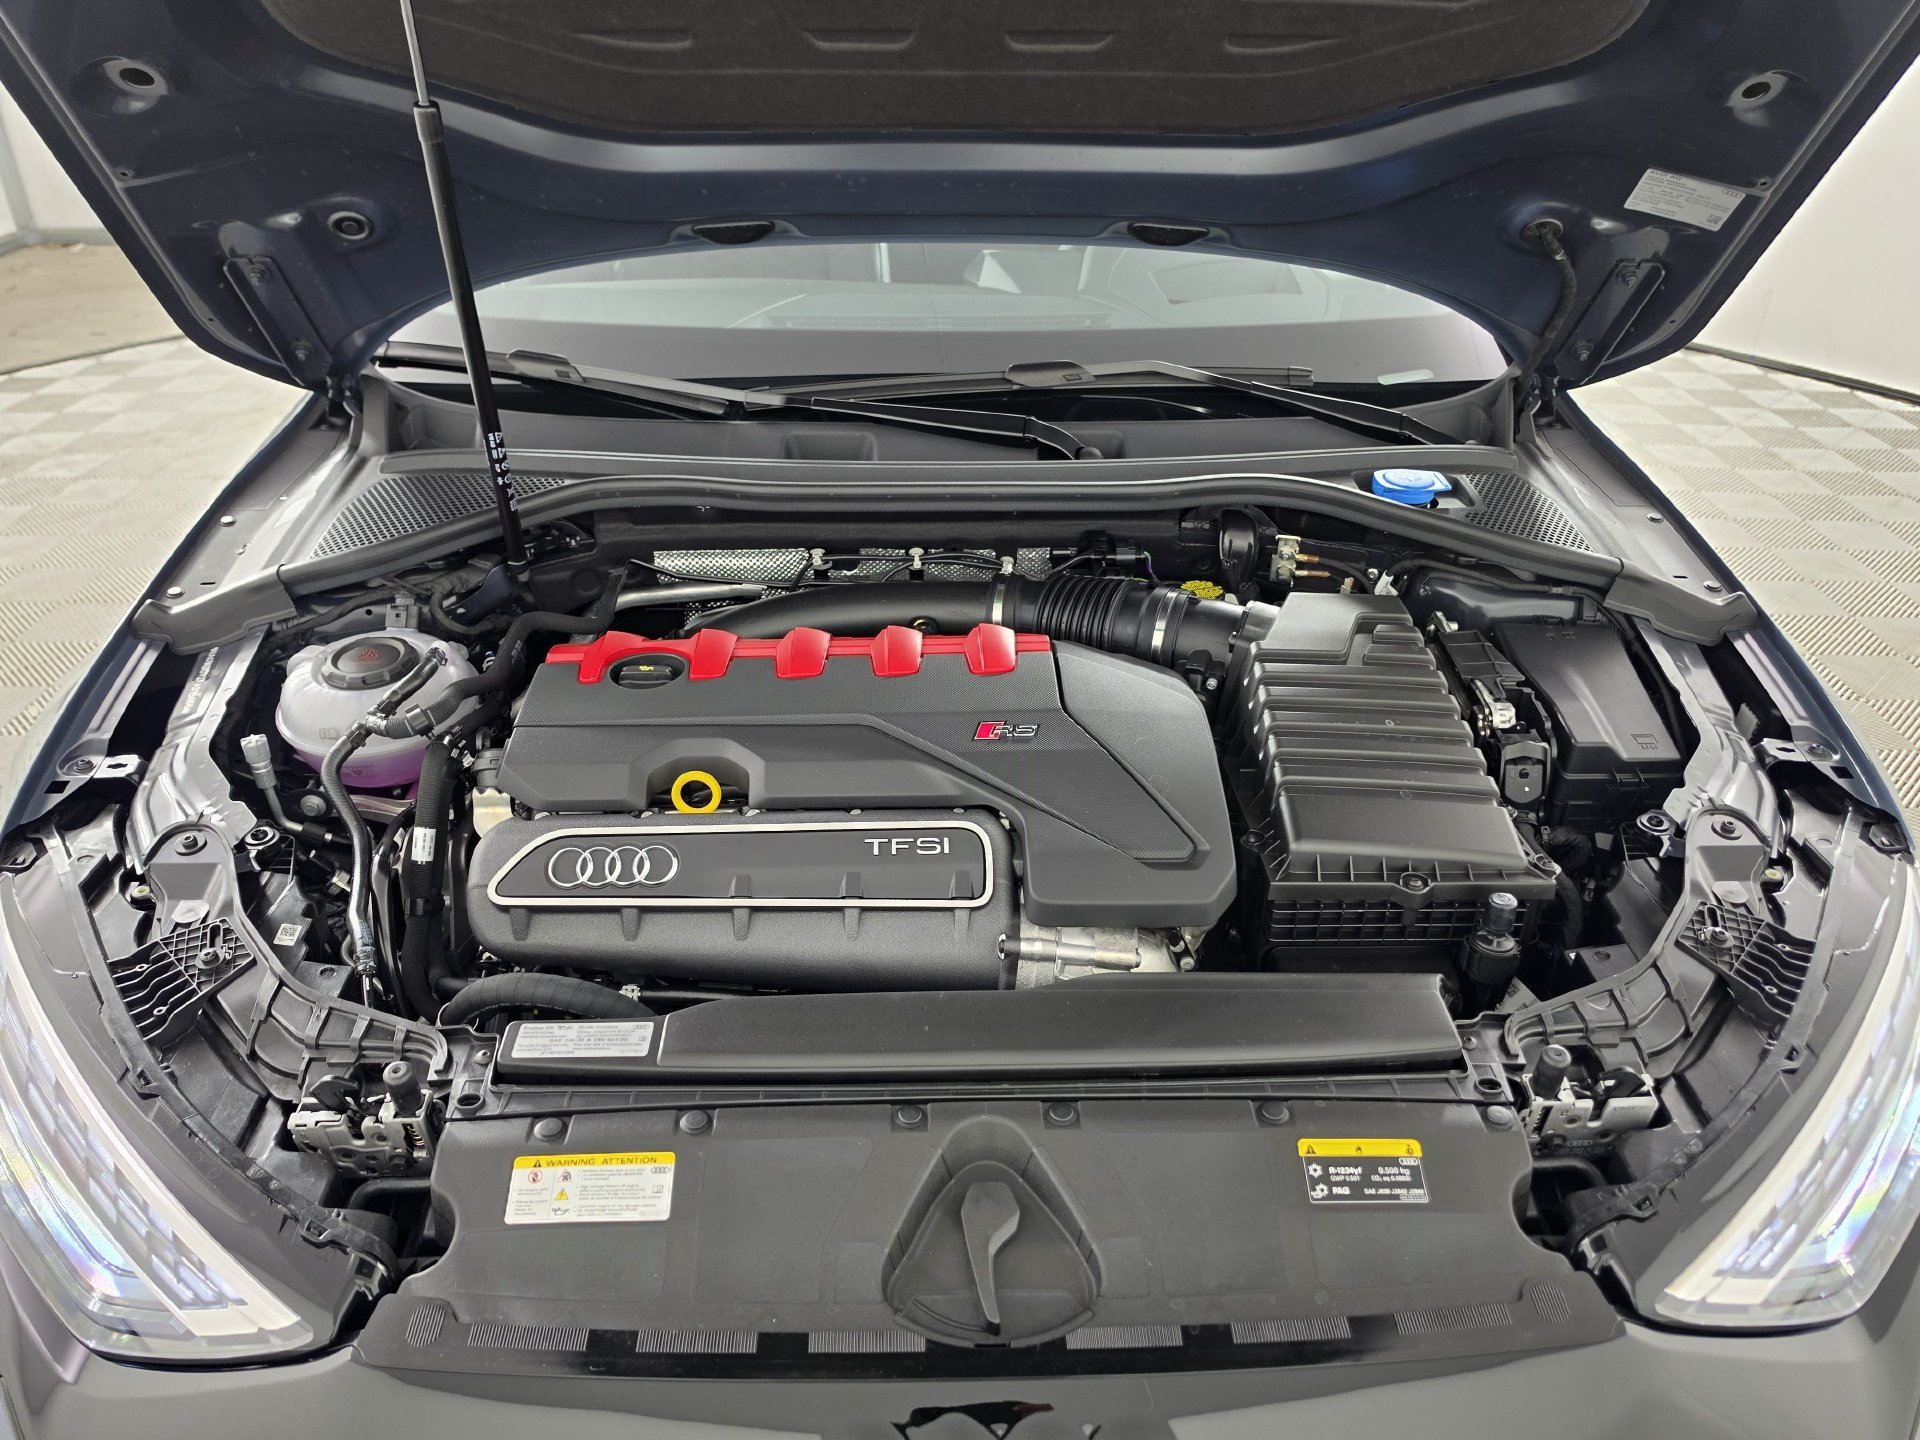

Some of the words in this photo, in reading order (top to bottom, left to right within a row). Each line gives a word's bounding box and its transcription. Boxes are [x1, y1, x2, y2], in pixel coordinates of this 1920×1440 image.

[864, 836, 951, 857] TFSI
[546, 1158, 596, 1167] WARNING
[601, 1156, 658, 1165] ATTENTION
[1328, 1166, 1363, 1175] R-1234yf
[1377, 1166, 1399, 1175] 0.500
[1399, 1166, 1410, 1176] kg
[1332, 1186, 1350, 1195] PAG
